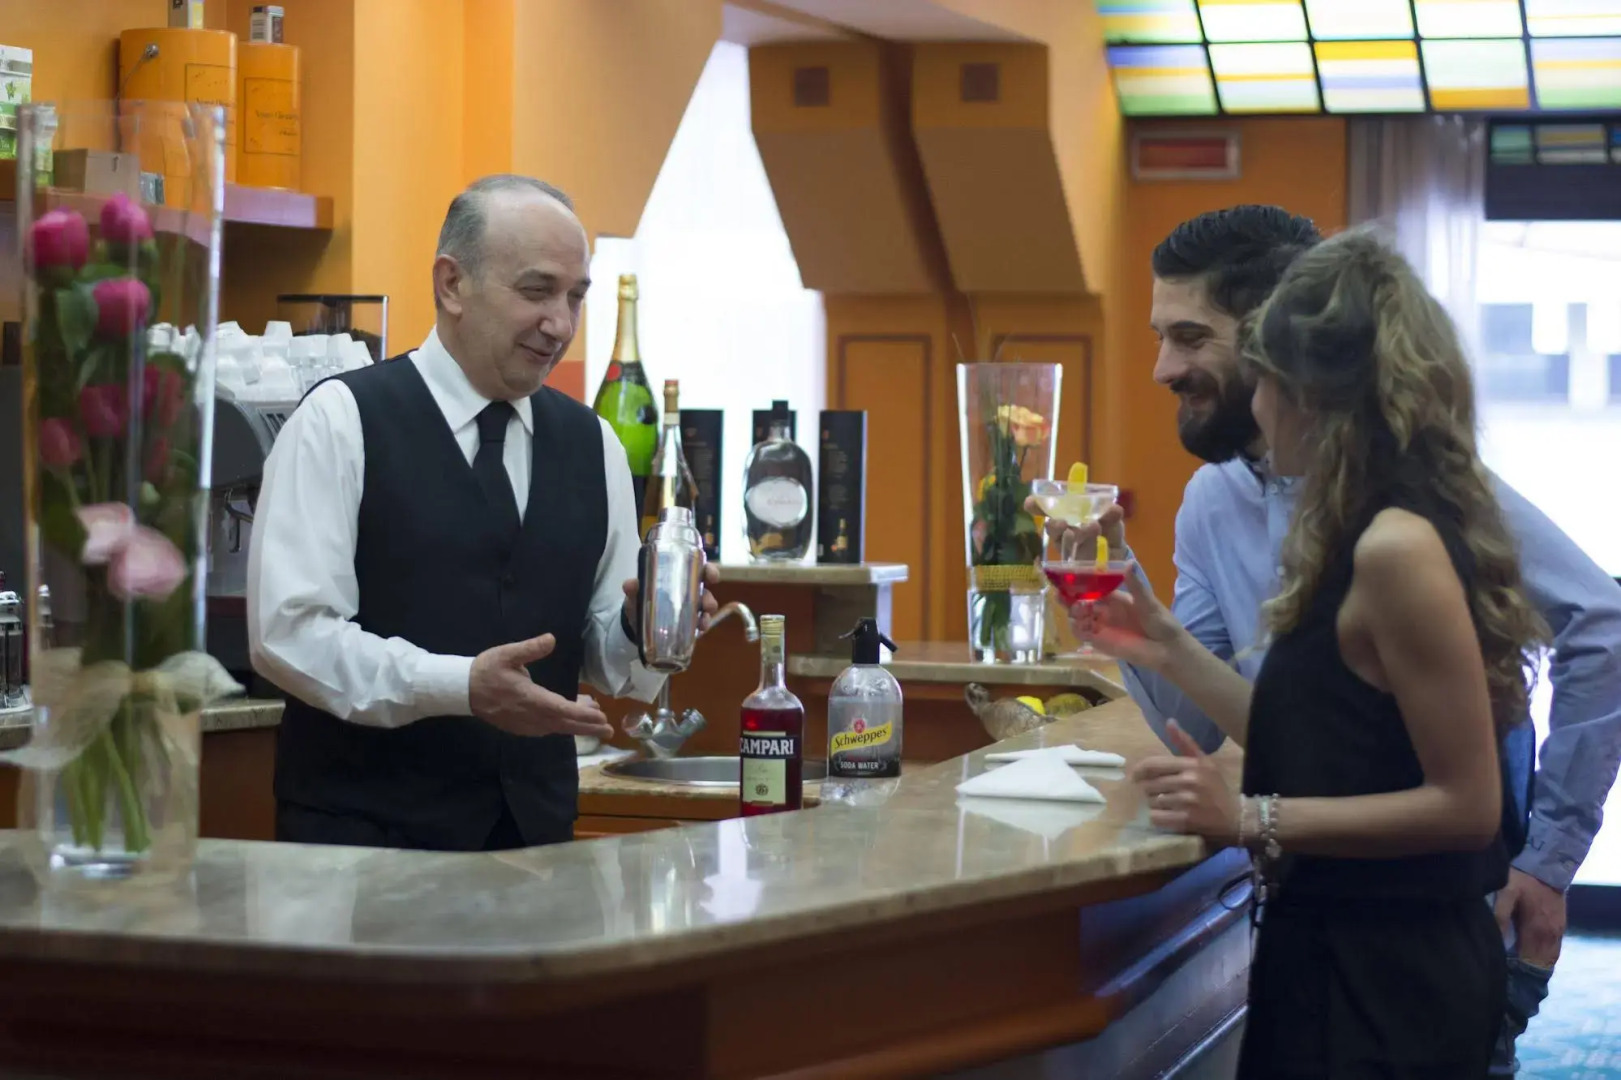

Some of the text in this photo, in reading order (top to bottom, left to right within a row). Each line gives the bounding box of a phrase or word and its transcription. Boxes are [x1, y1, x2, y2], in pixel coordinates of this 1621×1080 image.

[835, 728, 888, 749] Schweppes
[840, 761, 879, 769] SODA WATER
